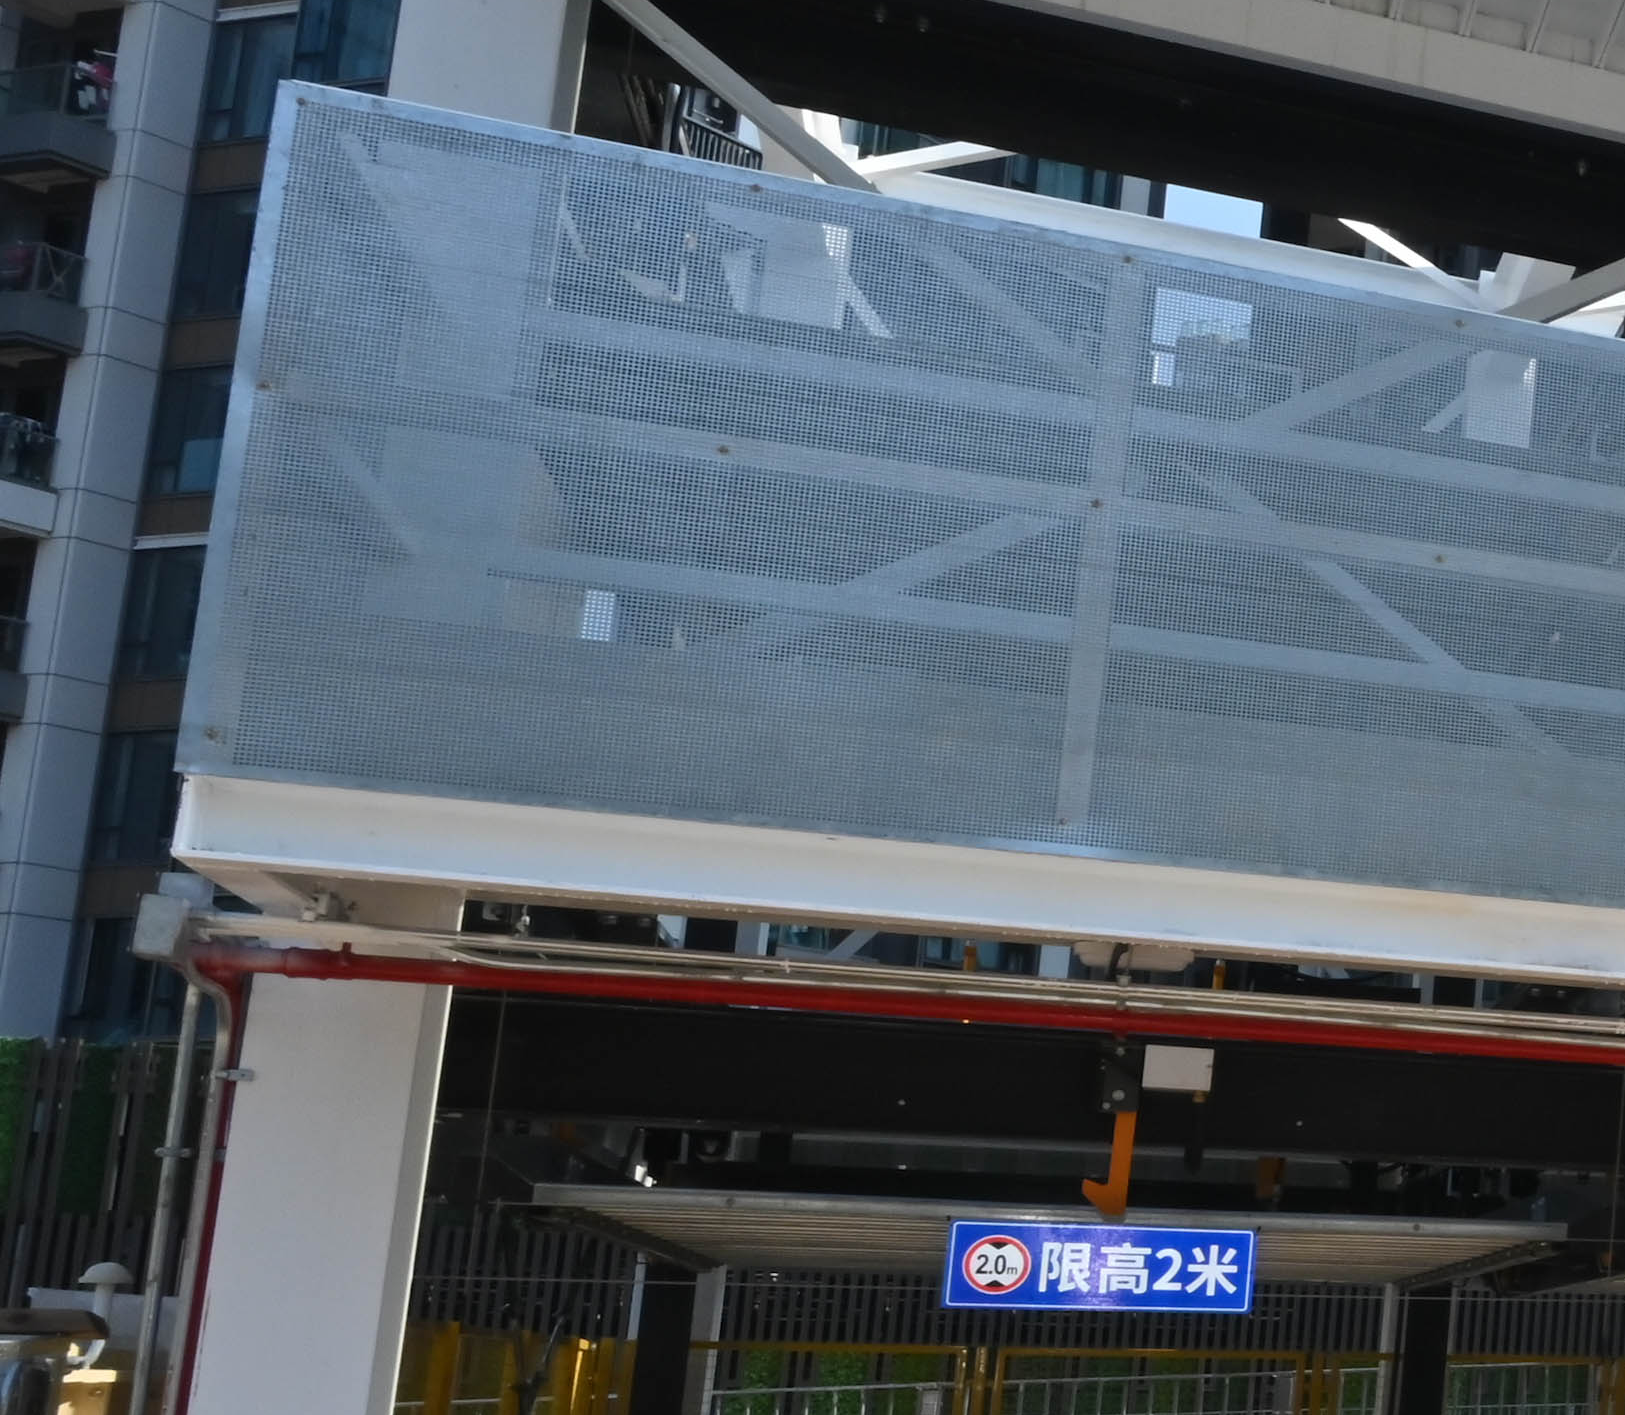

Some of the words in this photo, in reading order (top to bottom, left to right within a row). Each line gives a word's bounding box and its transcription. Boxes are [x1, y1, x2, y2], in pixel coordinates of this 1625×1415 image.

[975, 1253, 1018, 1276] 2.0m
[1038, 1242, 1239, 1297] 限高2米
